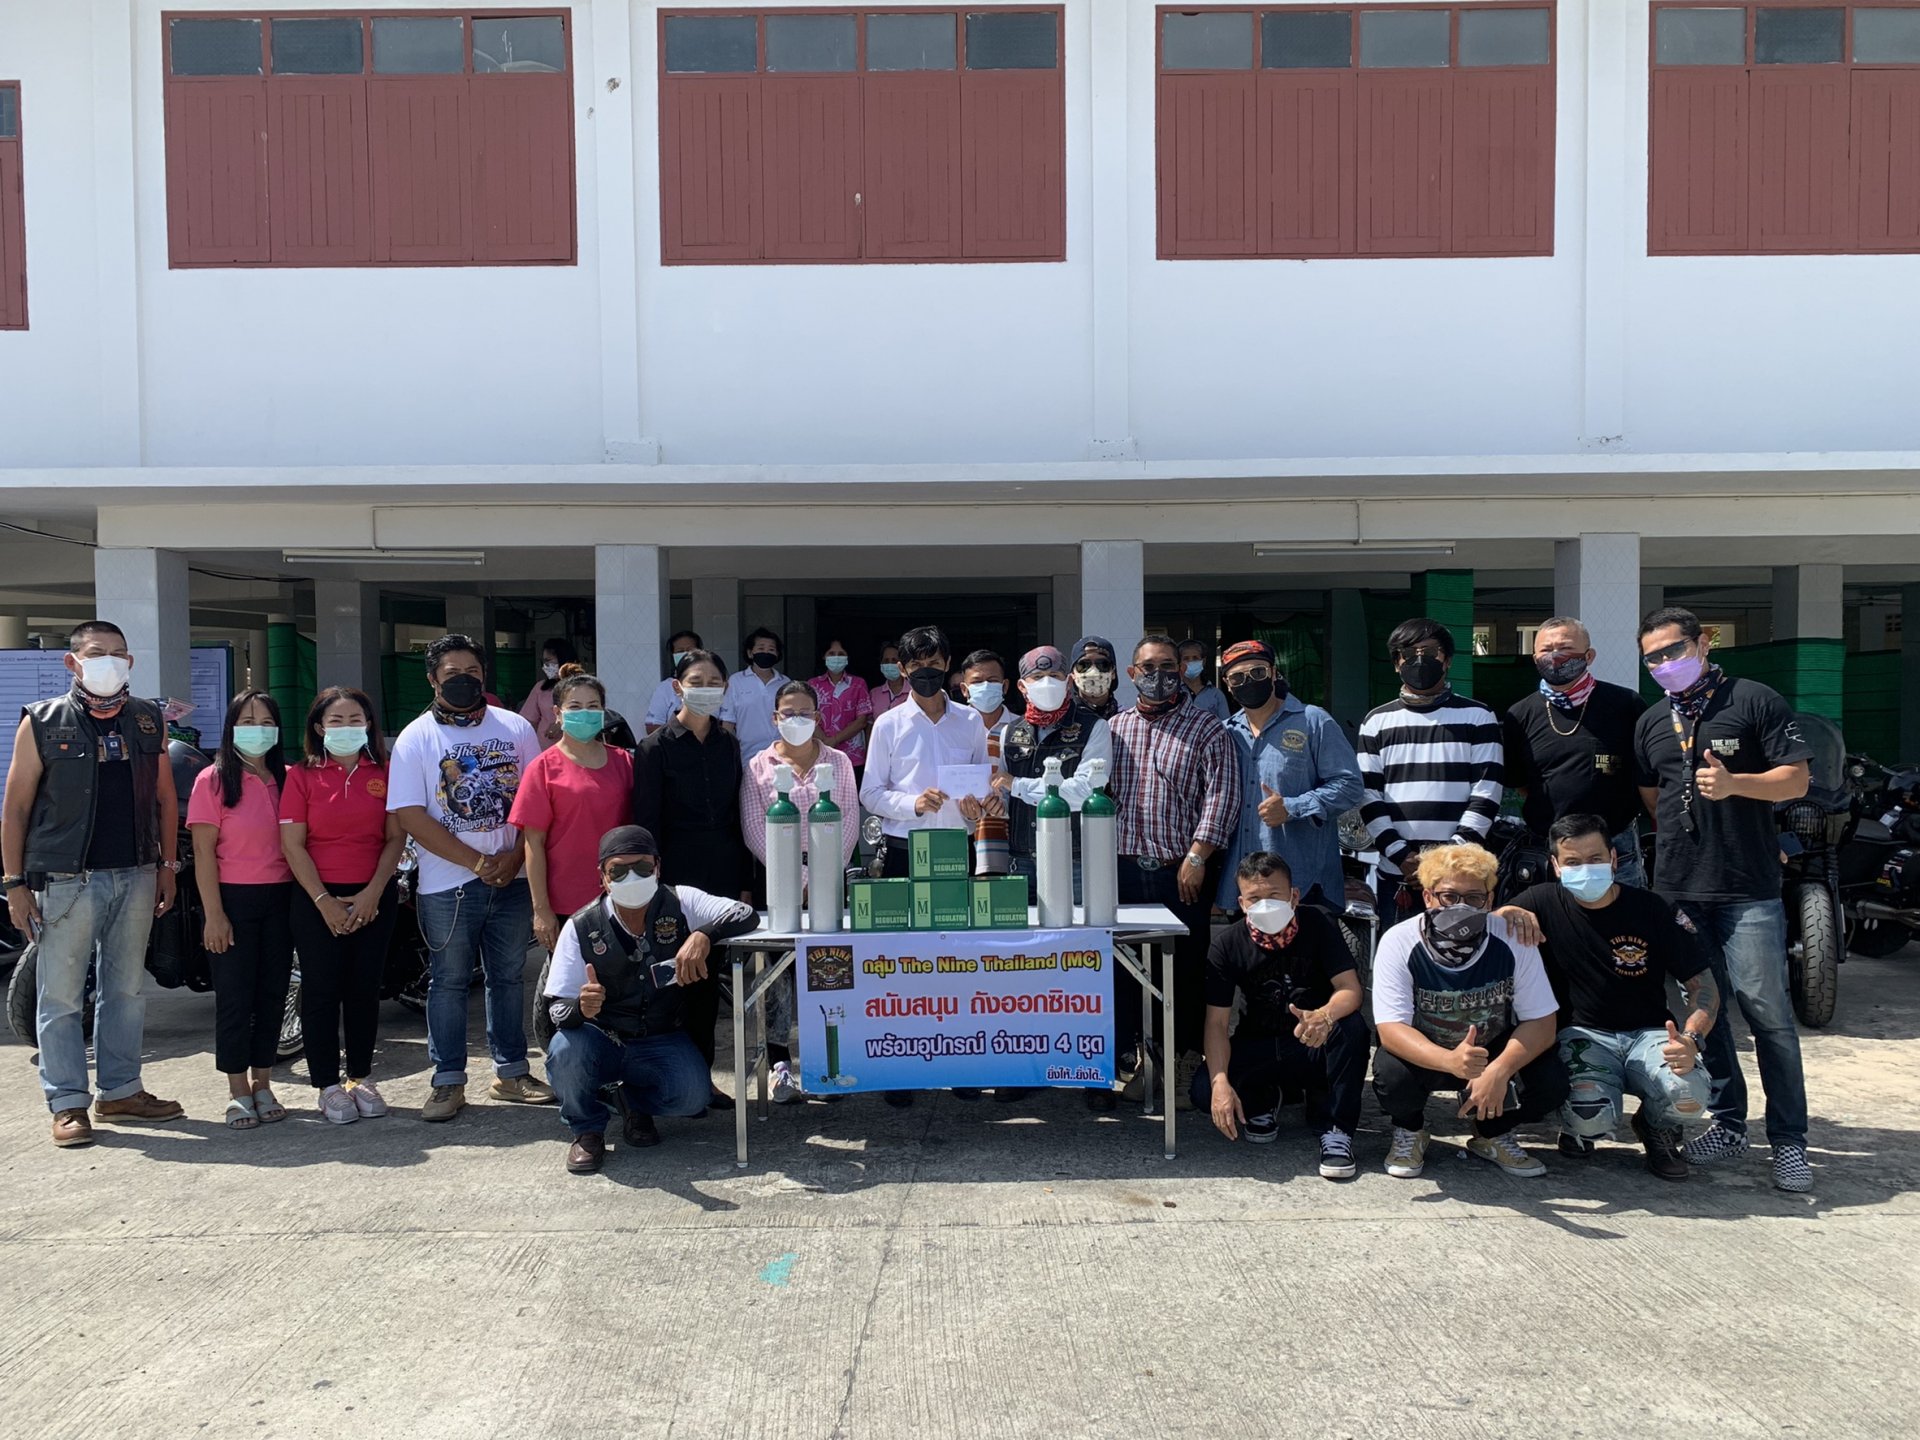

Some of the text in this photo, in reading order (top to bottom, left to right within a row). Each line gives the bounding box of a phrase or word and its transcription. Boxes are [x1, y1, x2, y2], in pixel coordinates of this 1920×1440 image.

[450, 738, 514, 760] The Nine
[916, 850, 928, 865] M
[934, 864, 966, 872] REGULATOR
[858, 903, 869, 916] M
[917, 901, 928, 914] M
[977, 901, 988, 914] M
[875, 916, 907, 924] REGULATOR
[935, 914, 967, 922] REGULATOR
[808, 948, 827, 962] THE
[863, 955, 895, 978] กลุ่ม
[899, 957, 933, 973] The
[937, 956, 978, 973] Nine
[981, 954, 1057, 972] Thailand
[1061, 950, 1101, 971] (MC)
[865, 990, 1102, 1022] สนับสนุน ถังออกซิเจน
[866, 1030, 1104, 1061] พร้อมอุปกรณ์ จำนวน 4 ชุด
